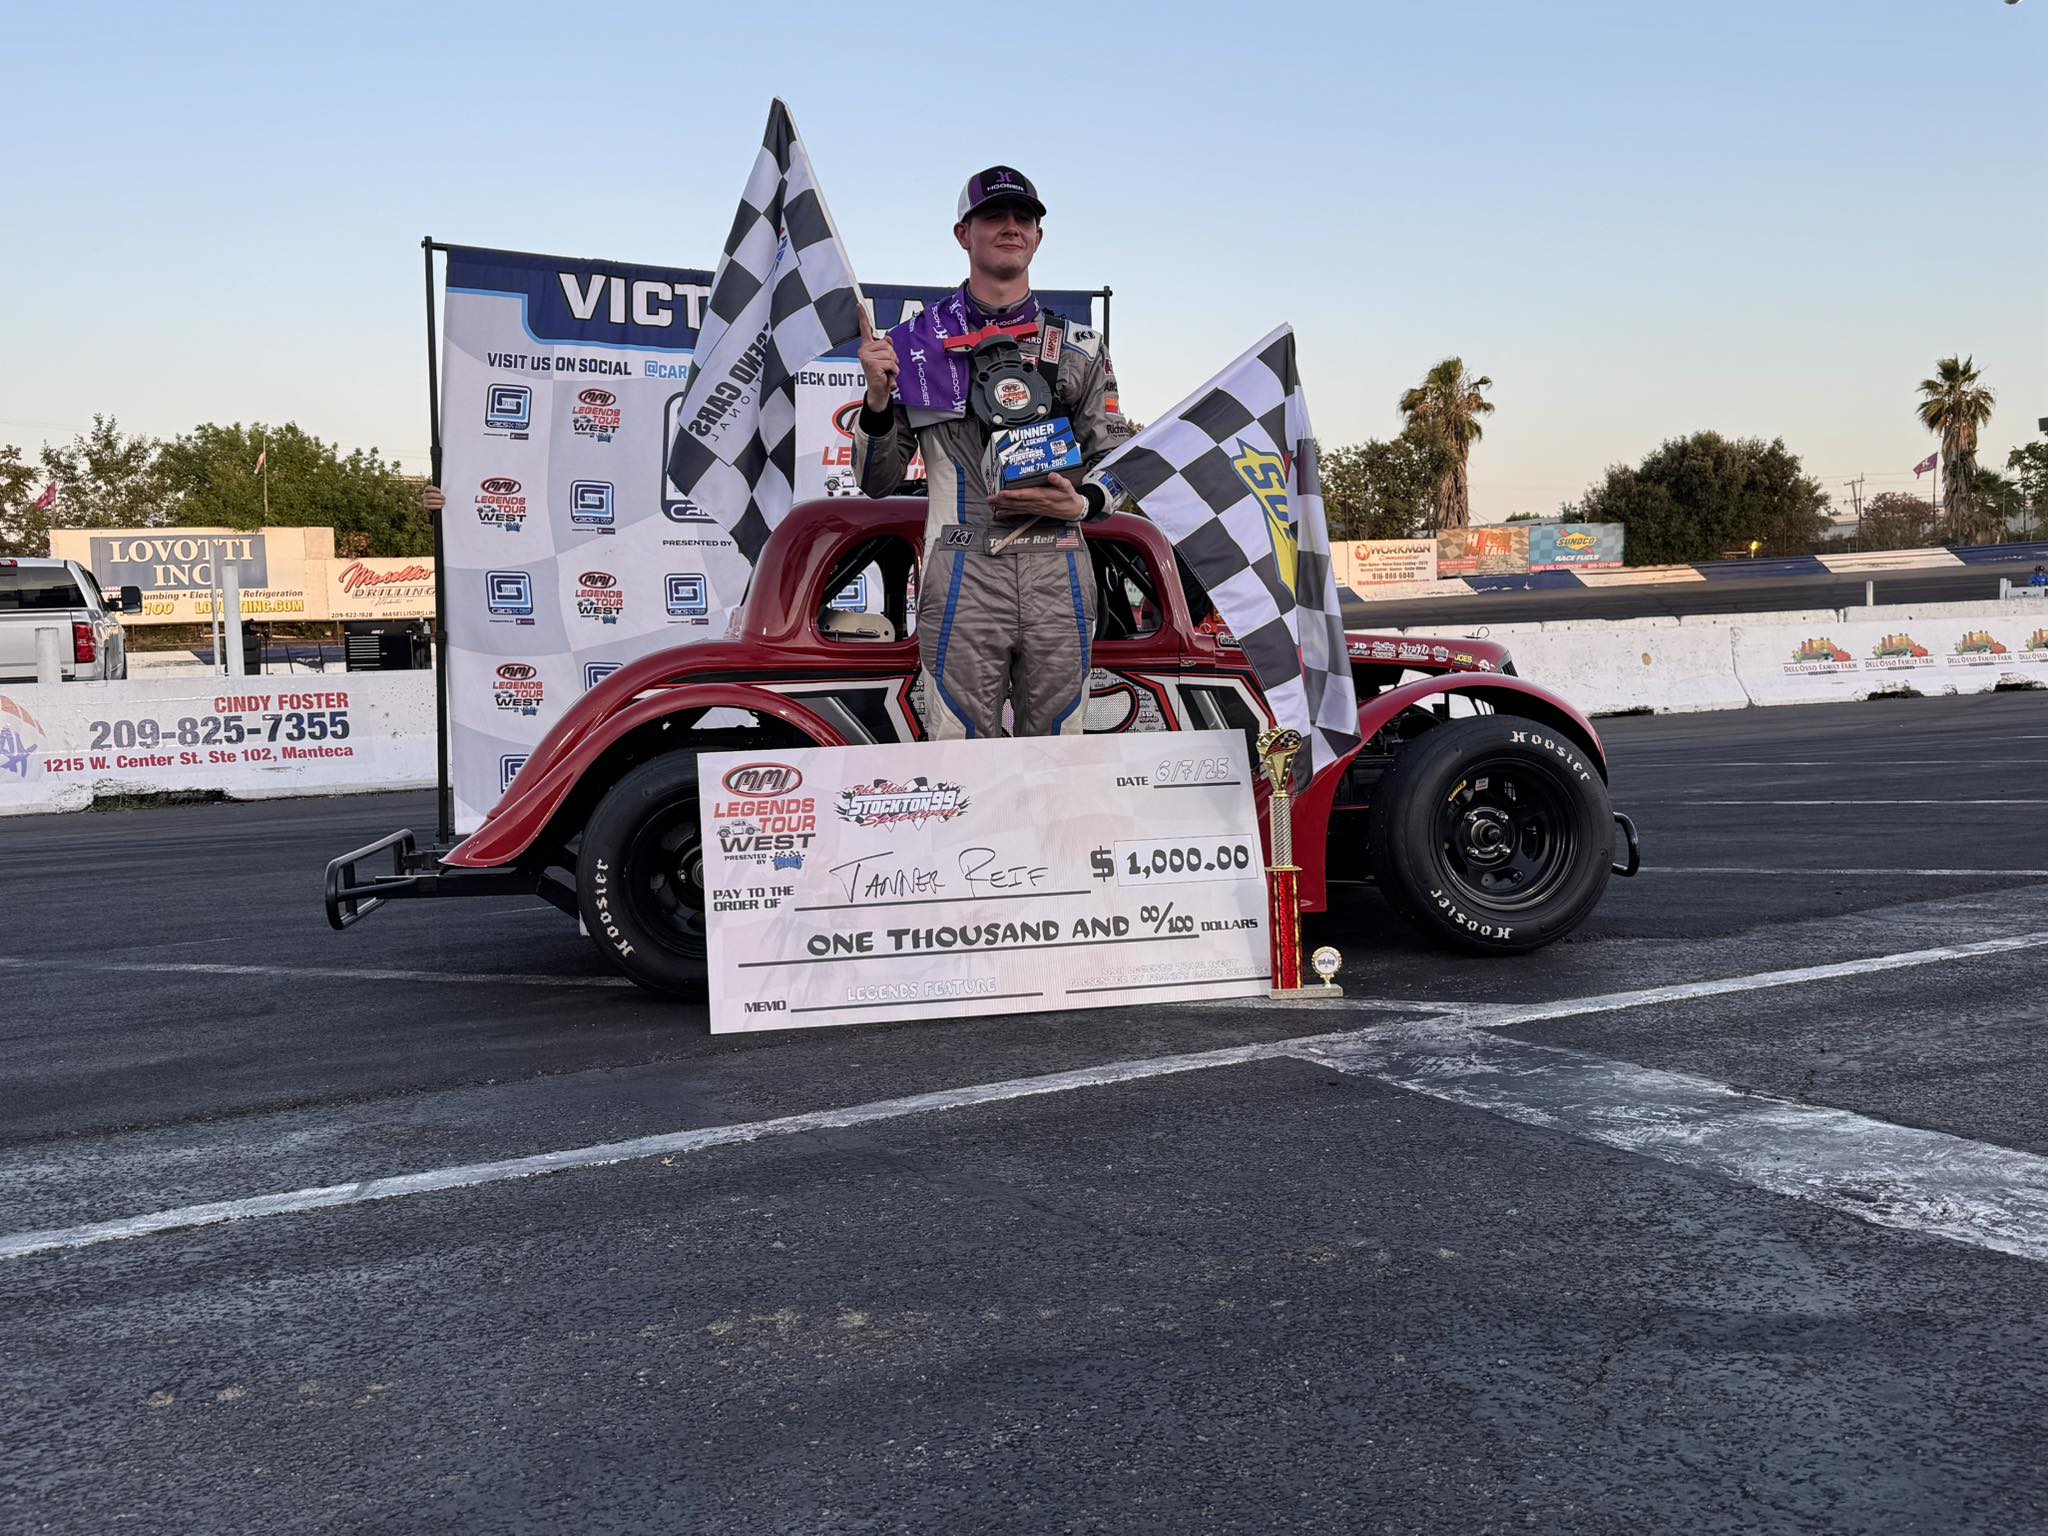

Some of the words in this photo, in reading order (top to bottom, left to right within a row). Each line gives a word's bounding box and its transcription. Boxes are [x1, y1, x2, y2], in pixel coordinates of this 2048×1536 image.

[558, 272, 713, 330] VICT
[1046, 329, 1059, 358] SIMPSON
[487, 352, 527, 369] VISIT
[531, 356, 551, 371] US
[555, 356, 575, 372] ON
[579, 358, 632, 375] SOCIAL
[644, 360, 690, 379] @CAR
[795, 372, 825, 386] HECK
[828, 373, 854, 386] OUT
[583, 391, 612, 405] MMI
[572, 407, 621, 416] LEGENDS
[592, 415, 621, 424] TOUR
[573, 423, 620, 433] WEST
[1008, 423, 1055, 442] WINNER
[1022, 436, 1048, 447] LEGENDS
[1019, 466, 1035, 474] JUNE
[1051, 457, 1067, 467] 2025
[486, 480, 517, 494] MMI
[474, 495, 526, 504] LEGENDS
[497, 504, 526, 513] TOUR
[478, 513, 527, 522] WEST
[1033, 534, 1055, 545] Reif
[1558, 537, 1596, 546] SUNOCO
[109, 539, 254, 563] LOVOTTI
[1371, 544, 1431, 554] WORKMAN
[583, 574, 612, 586] MMI
[243, 589, 303, 599] Refrigeration
[353, 586, 435, 597] DRILLING
[575, 589, 623, 598] LEGENDS
[594, 598, 624, 606] TOUR
[578, 606, 623, 615] WEST
[1454, 654, 1473, 662] JOES
[1897, 658, 1918, 666] FAMILY
[501, 665, 532, 679] MMI
[492, 681, 543, 690] LEGENDS
[514, 690, 543, 698] TOUR
[214, 695, 271, 713] CINDY
[278, 692, 349, 710] FOSTER
[495, 698, 544, 706] WEST
[89, 710, 350, 751] 209-825-7355
[44, 758, 84, 772] 1215
[89, 756, 110, 770] W.
[116, 754, 174, 769] Center
[181, 751, 203, 765] St.
[209, 750, 237, 764] Ste
[242, 748, 277, 762] 102,
[281, 745, 353, 760] Manteca
[1510, 731, 1590, 781] Hoosier
[1116, 775, 1149, 786] DATE
[1155, 757, 1230, 783] 6/7/25
[731, 767, 795, 793] MMI
[714, 798, 815, 818] LEGENDS
[759, 815, 816, 833] TOUR
[720, 833, 816, 853] WEST
[1090, 844, 1115, 883] $
[1127, 844, 1249, 879] 1,000.00
[829, 851, 945, 903] TANNER
[713, 889, 744, 900] PAY
[748, 887, 765, 898] TO
[770, 885, 795, 897] THE
[595, 858, 636, 958] Hoosier
[713, 900, 759, 912] ORDER
[764, 899, 782, 909] OF
[1430, 889, 1514, 939] Hoosier
[1200, 918, 1258, 932] DOLLARS
[807, 931, 874, 956] ONE
[887, 920, 1060, 951] THOUSAND
[1072, 916, 1129, 939] AND
[846, 982, 918, 1001] LEGENDS
[924, 976, 996, 996] FEATURE
[744, 1000, 787, 1014] MEMO
